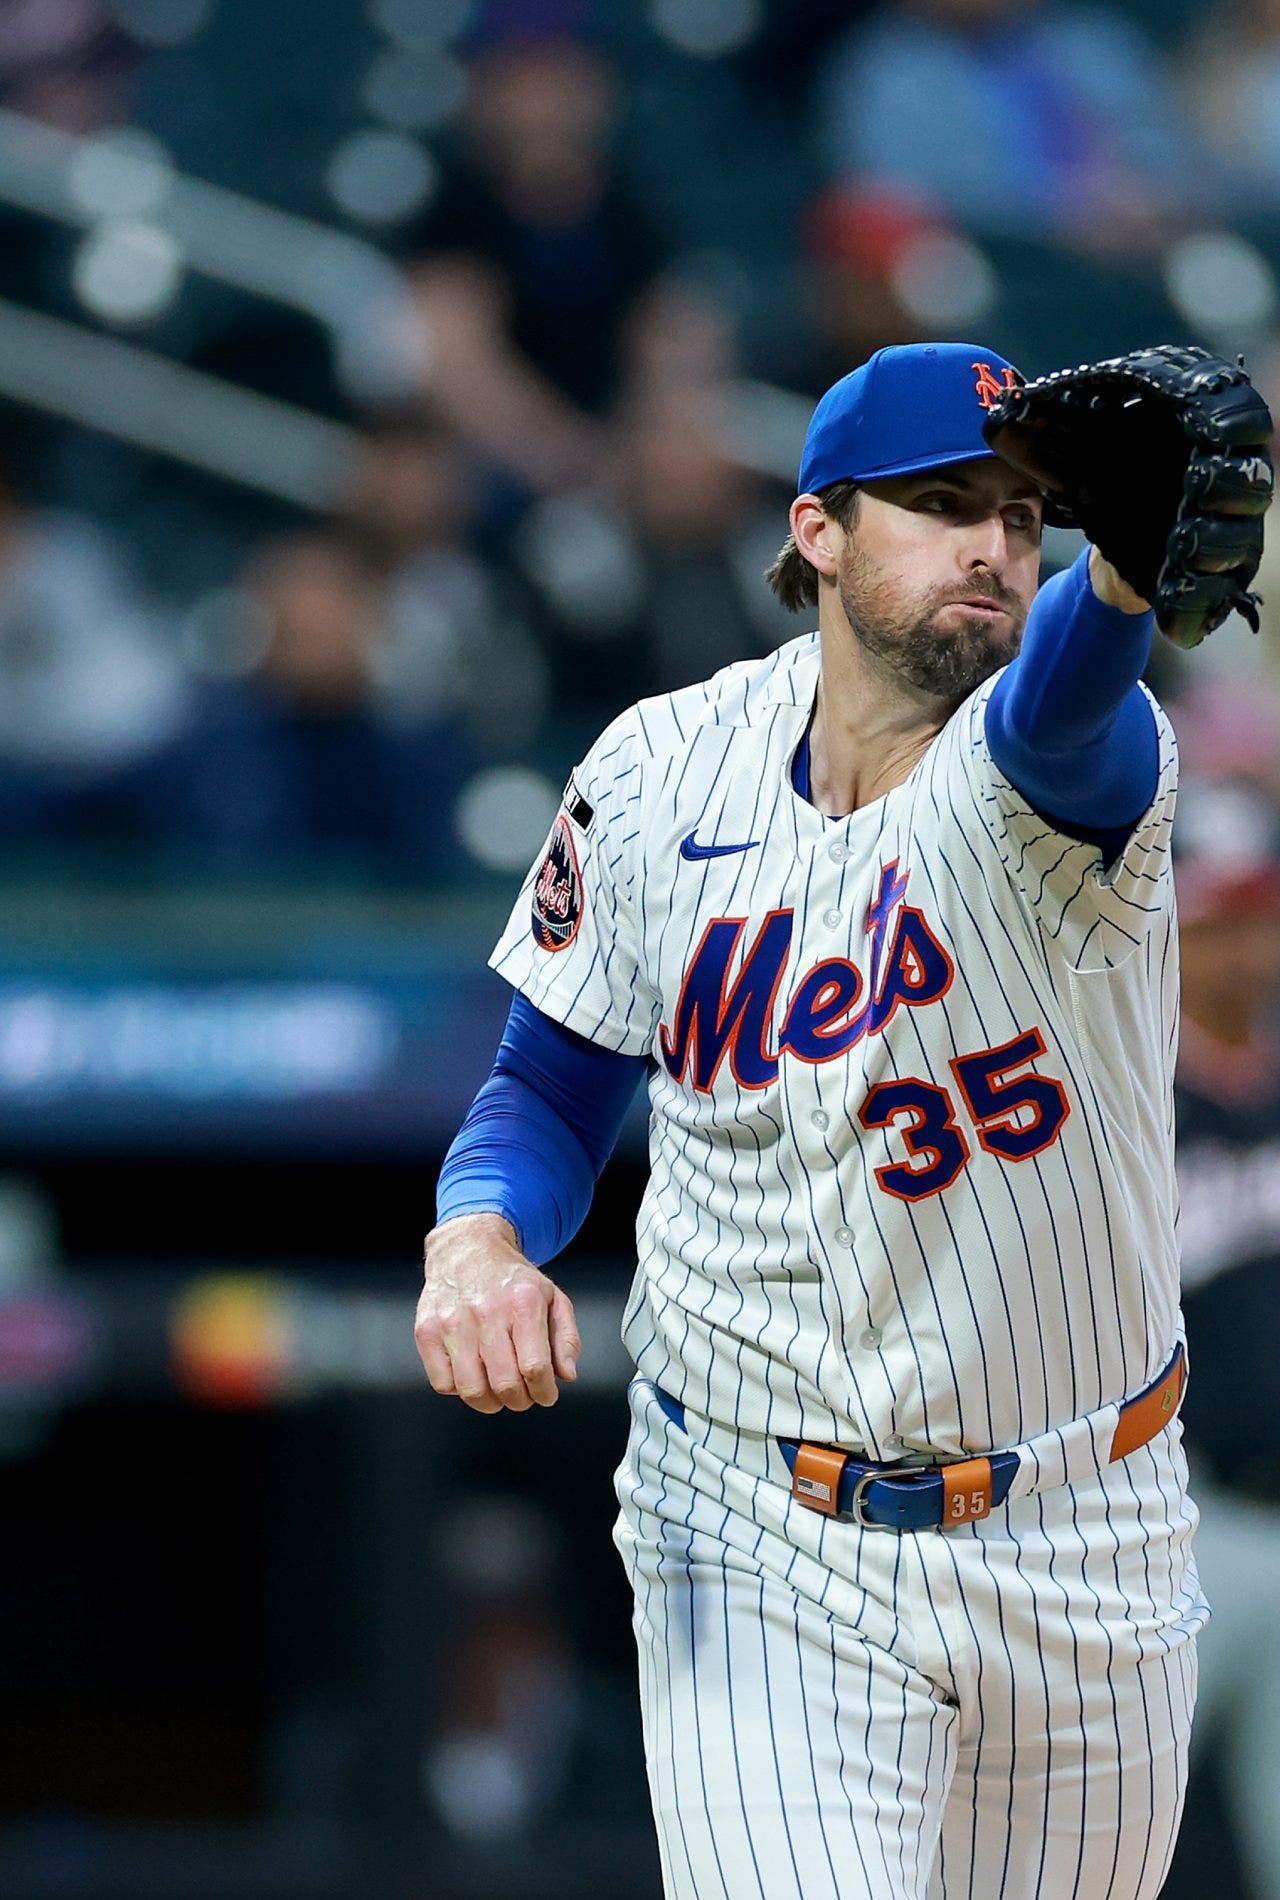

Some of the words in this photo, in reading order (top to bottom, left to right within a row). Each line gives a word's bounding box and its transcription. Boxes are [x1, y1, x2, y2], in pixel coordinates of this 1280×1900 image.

[659, 857, 955, 1094] Mets
[857, 1025, 1071, 1203] 35
[951, 1490, 985, 1519] 35
